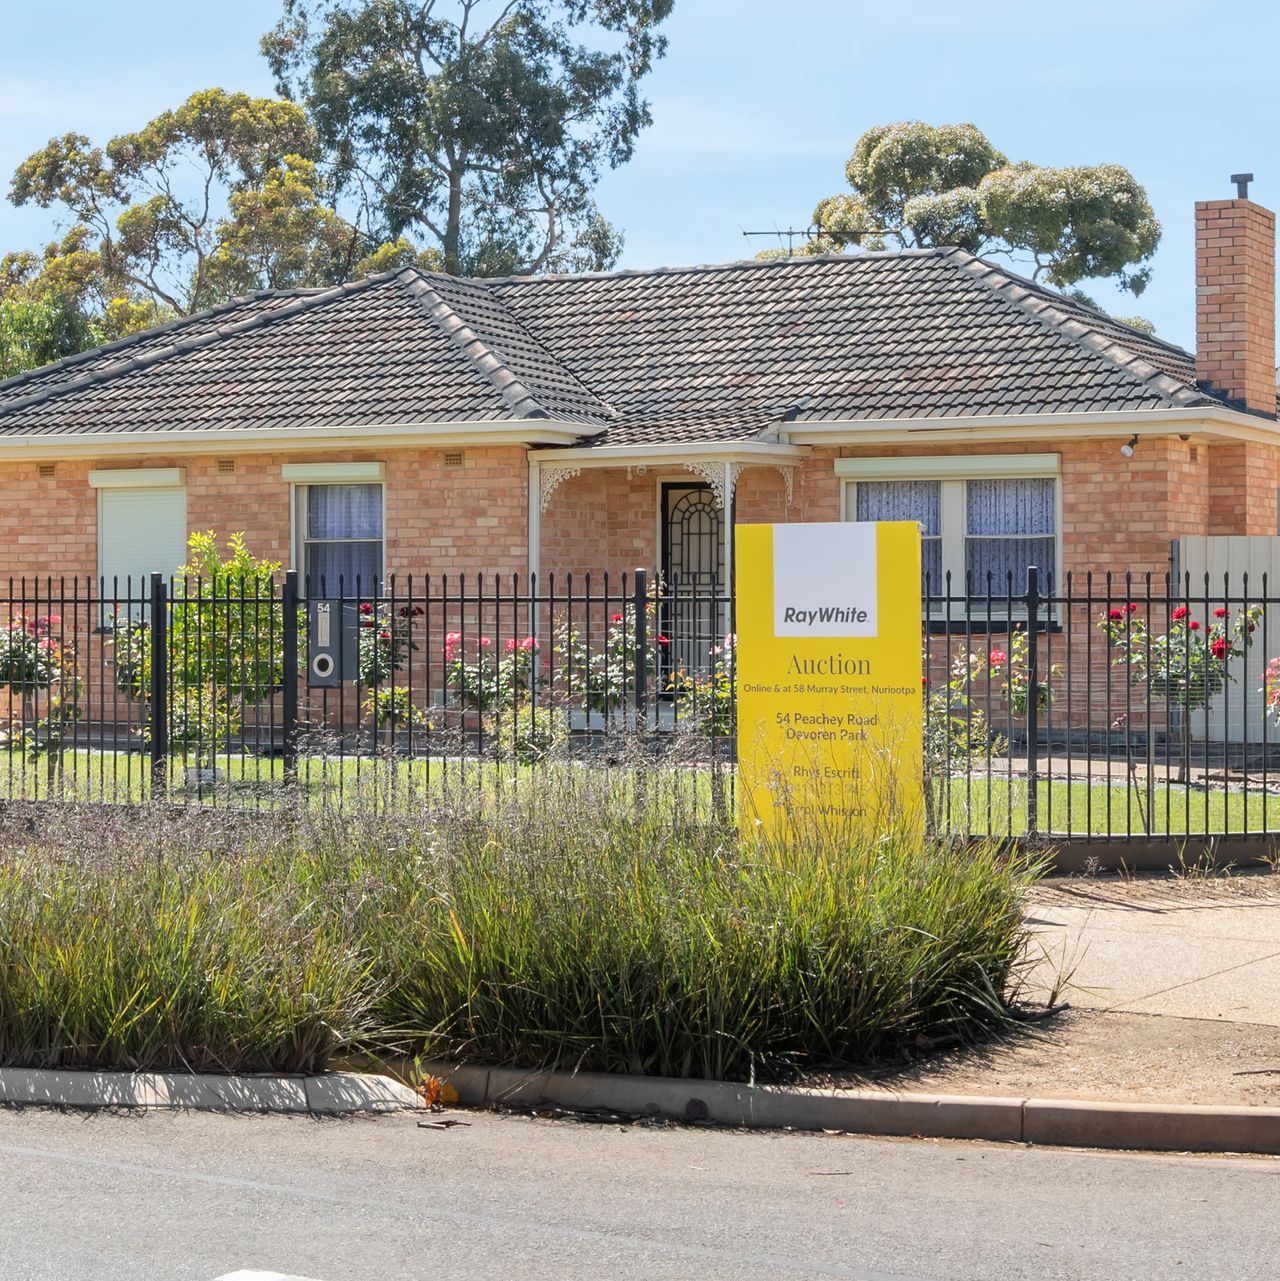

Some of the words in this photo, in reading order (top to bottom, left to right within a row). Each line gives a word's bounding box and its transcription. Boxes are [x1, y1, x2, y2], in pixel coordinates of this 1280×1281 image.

[317, 603, 330, 613] 54
[787, 653, 871, 675] Auction
[743, 683, 772, 693] Online
[773, 684, 781, 693] &
[782, 685, 791, 693] at
[793, 684, 805, 693] 58
[807, 684, 839, 695] Murray
[871, 685, 916, 696] Nuriootpa
[776, 712, 790, 724] 54
[794, 713, 844, 727] Peachey
[847, 714, 878, 726] Road
[786, 727, 837, 741] Davoren
[840, 729, 868, 741] Park
